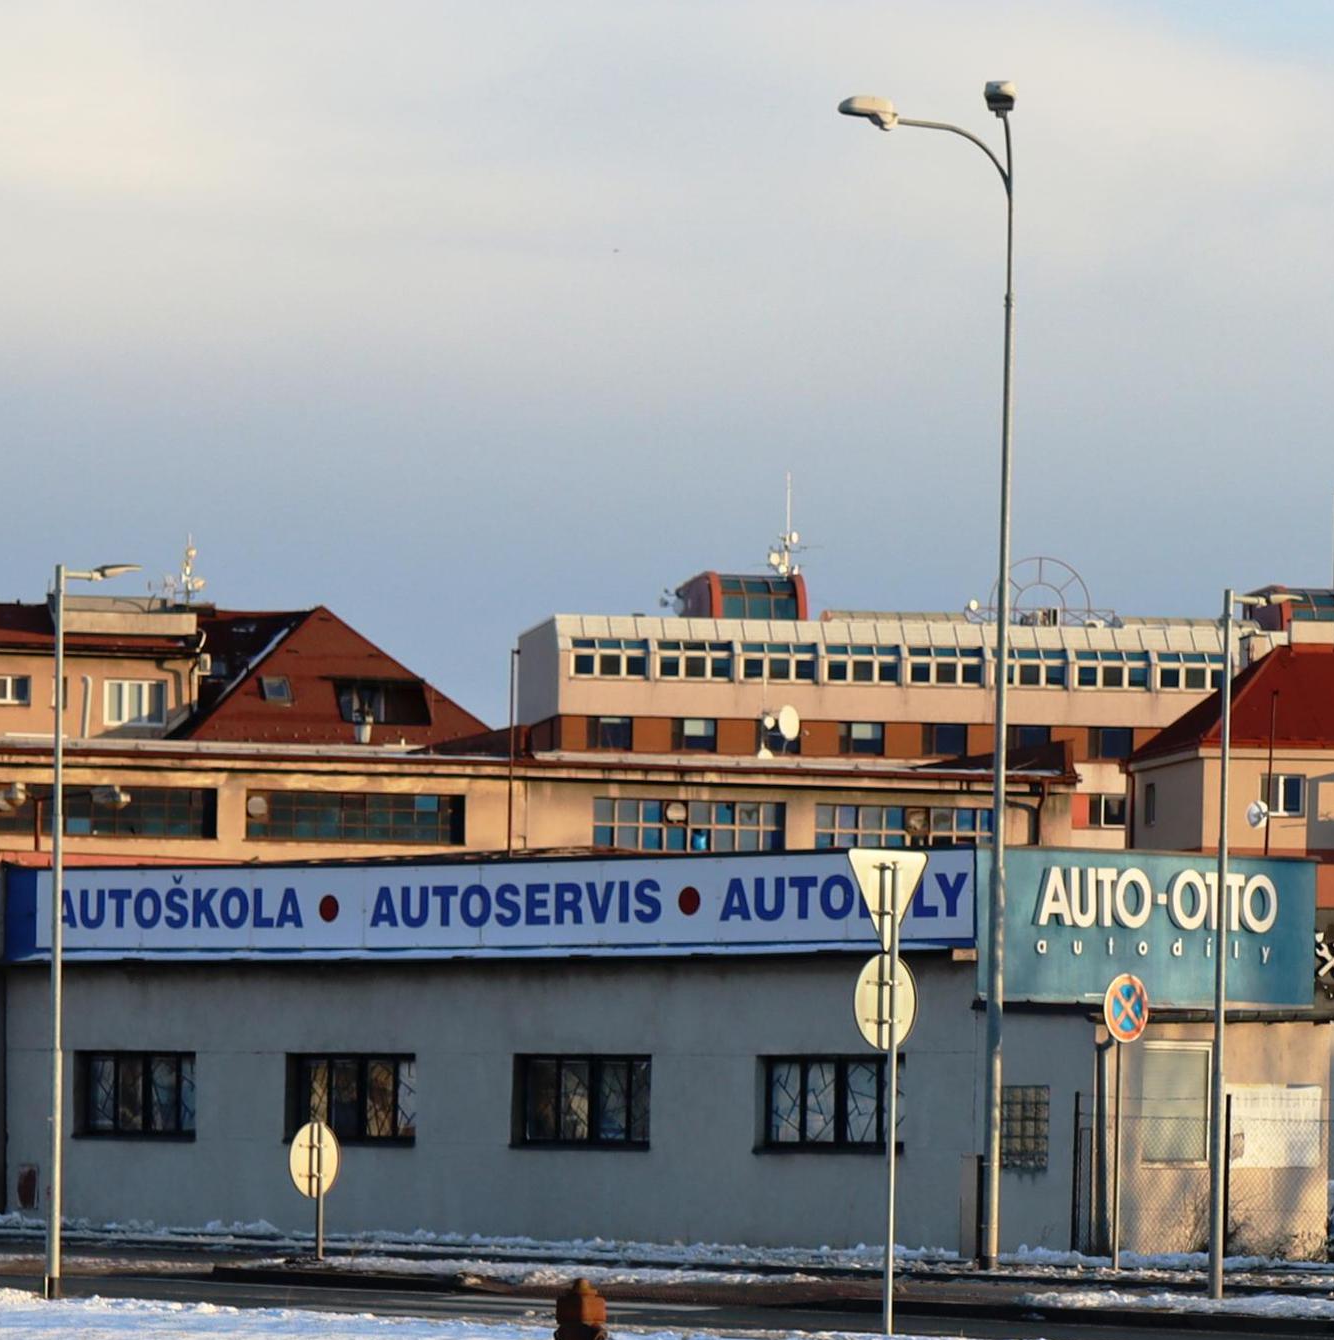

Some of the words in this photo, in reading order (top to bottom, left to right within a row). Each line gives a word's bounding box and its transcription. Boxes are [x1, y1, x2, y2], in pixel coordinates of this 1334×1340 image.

[62, 874, 304, 930] AUTOŠKOLA
[370, 878, 662, 928] AUTOSERVIS
[720, 872, 968, 921] AUTOLY
[1036, 936, 1271, 964] autodíly
